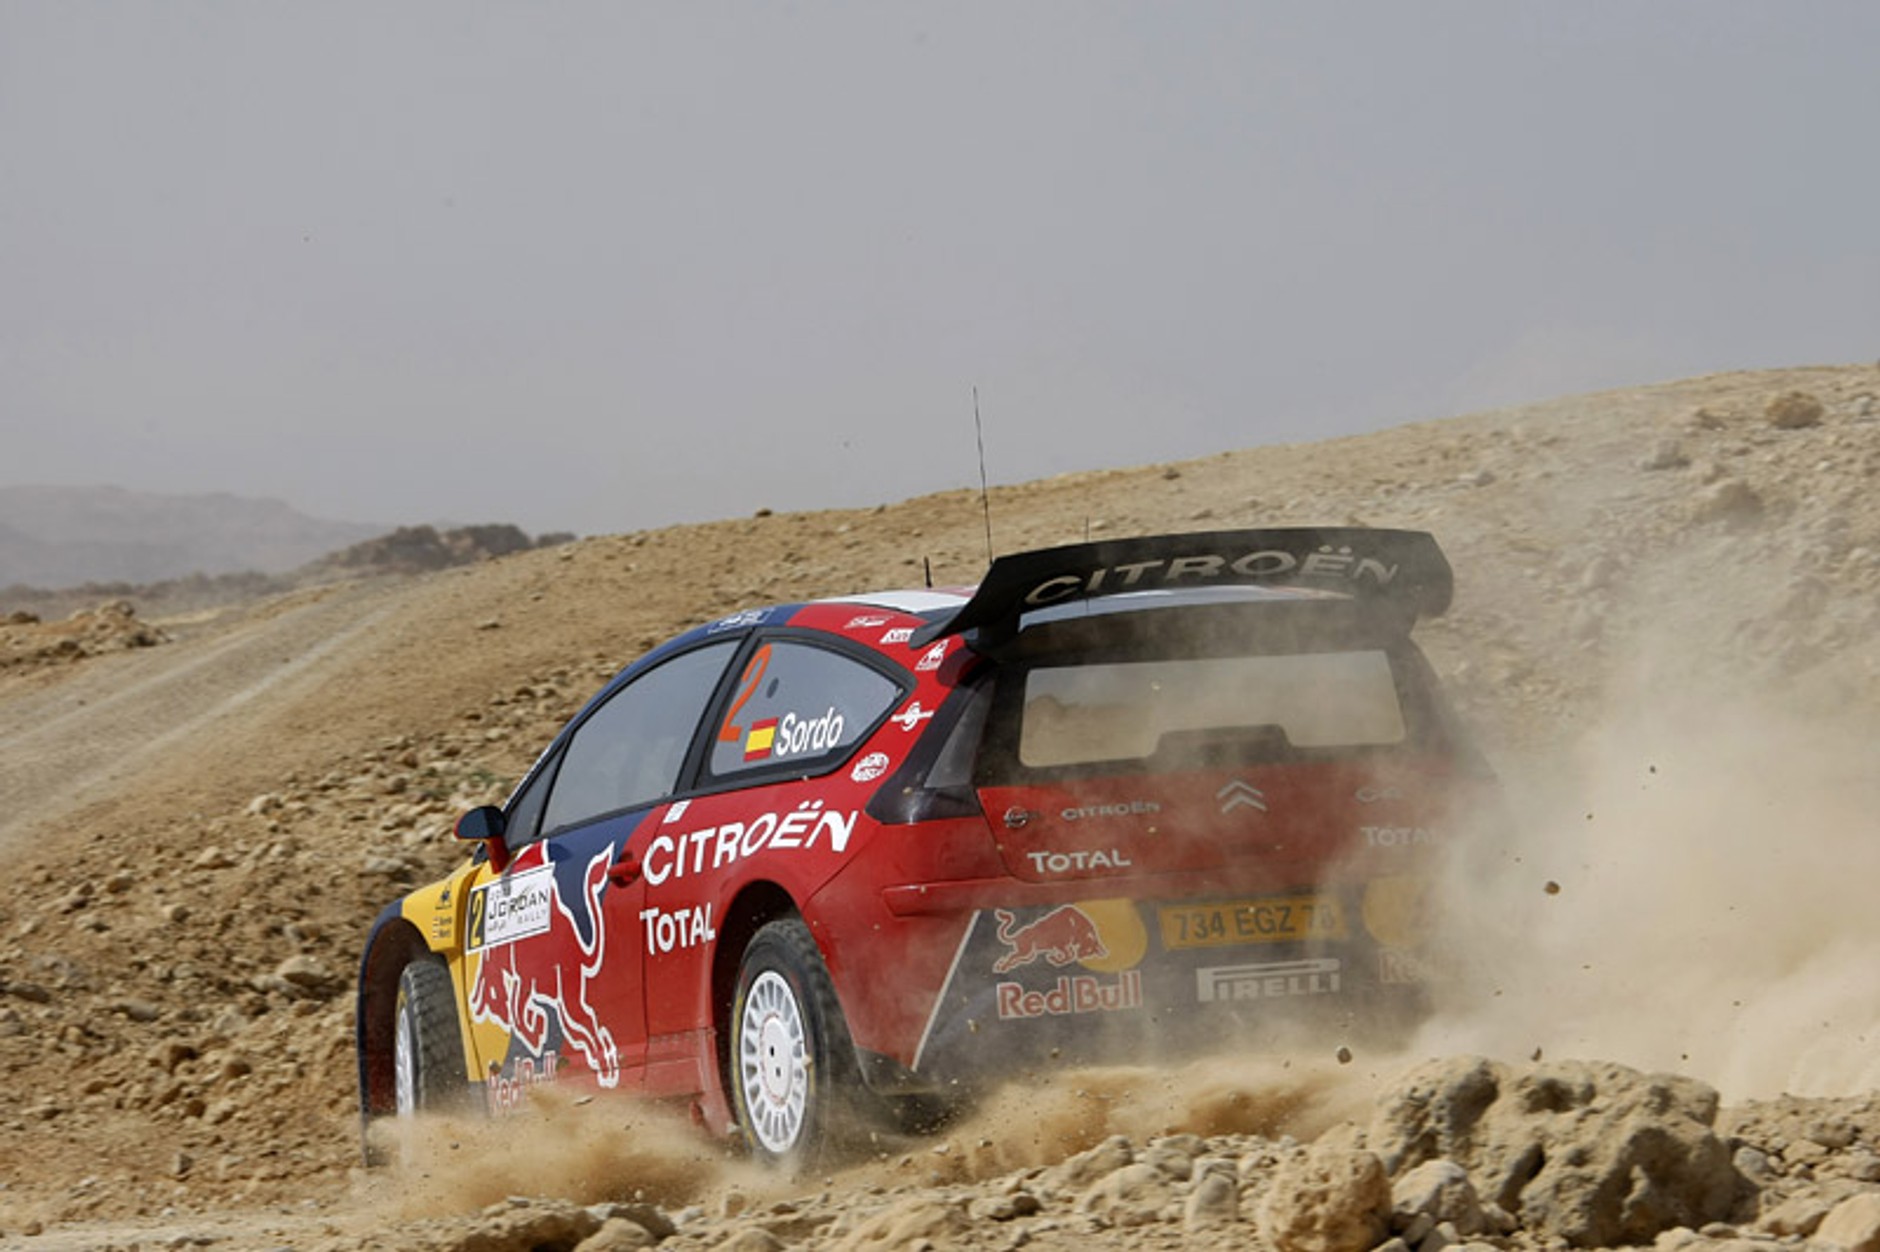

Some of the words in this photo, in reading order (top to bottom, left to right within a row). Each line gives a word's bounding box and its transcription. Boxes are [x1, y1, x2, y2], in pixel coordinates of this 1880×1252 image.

[1025, 545, 1398, 604] CITROËN
[717, 643, 772, 742] 2
[776, 708, 843, 756] Sordo
[642, 800, 858, 885] CITROËN
[1027, 849, 1131, 873] TOTAL
[470, 888, 484, 947] 2
[489, 887, 549, 919] JORDAN
[639, 902, 716, 955] TOTAL
[1173, 910, 1226, 940] 734
[1234, 905, 1296, 936] EGZ
[997, 974, 1072, 1020] Red
[1071, 969, 1143, 1014] Bull
[1196, 957, 1341, 1002] PIRELLI
